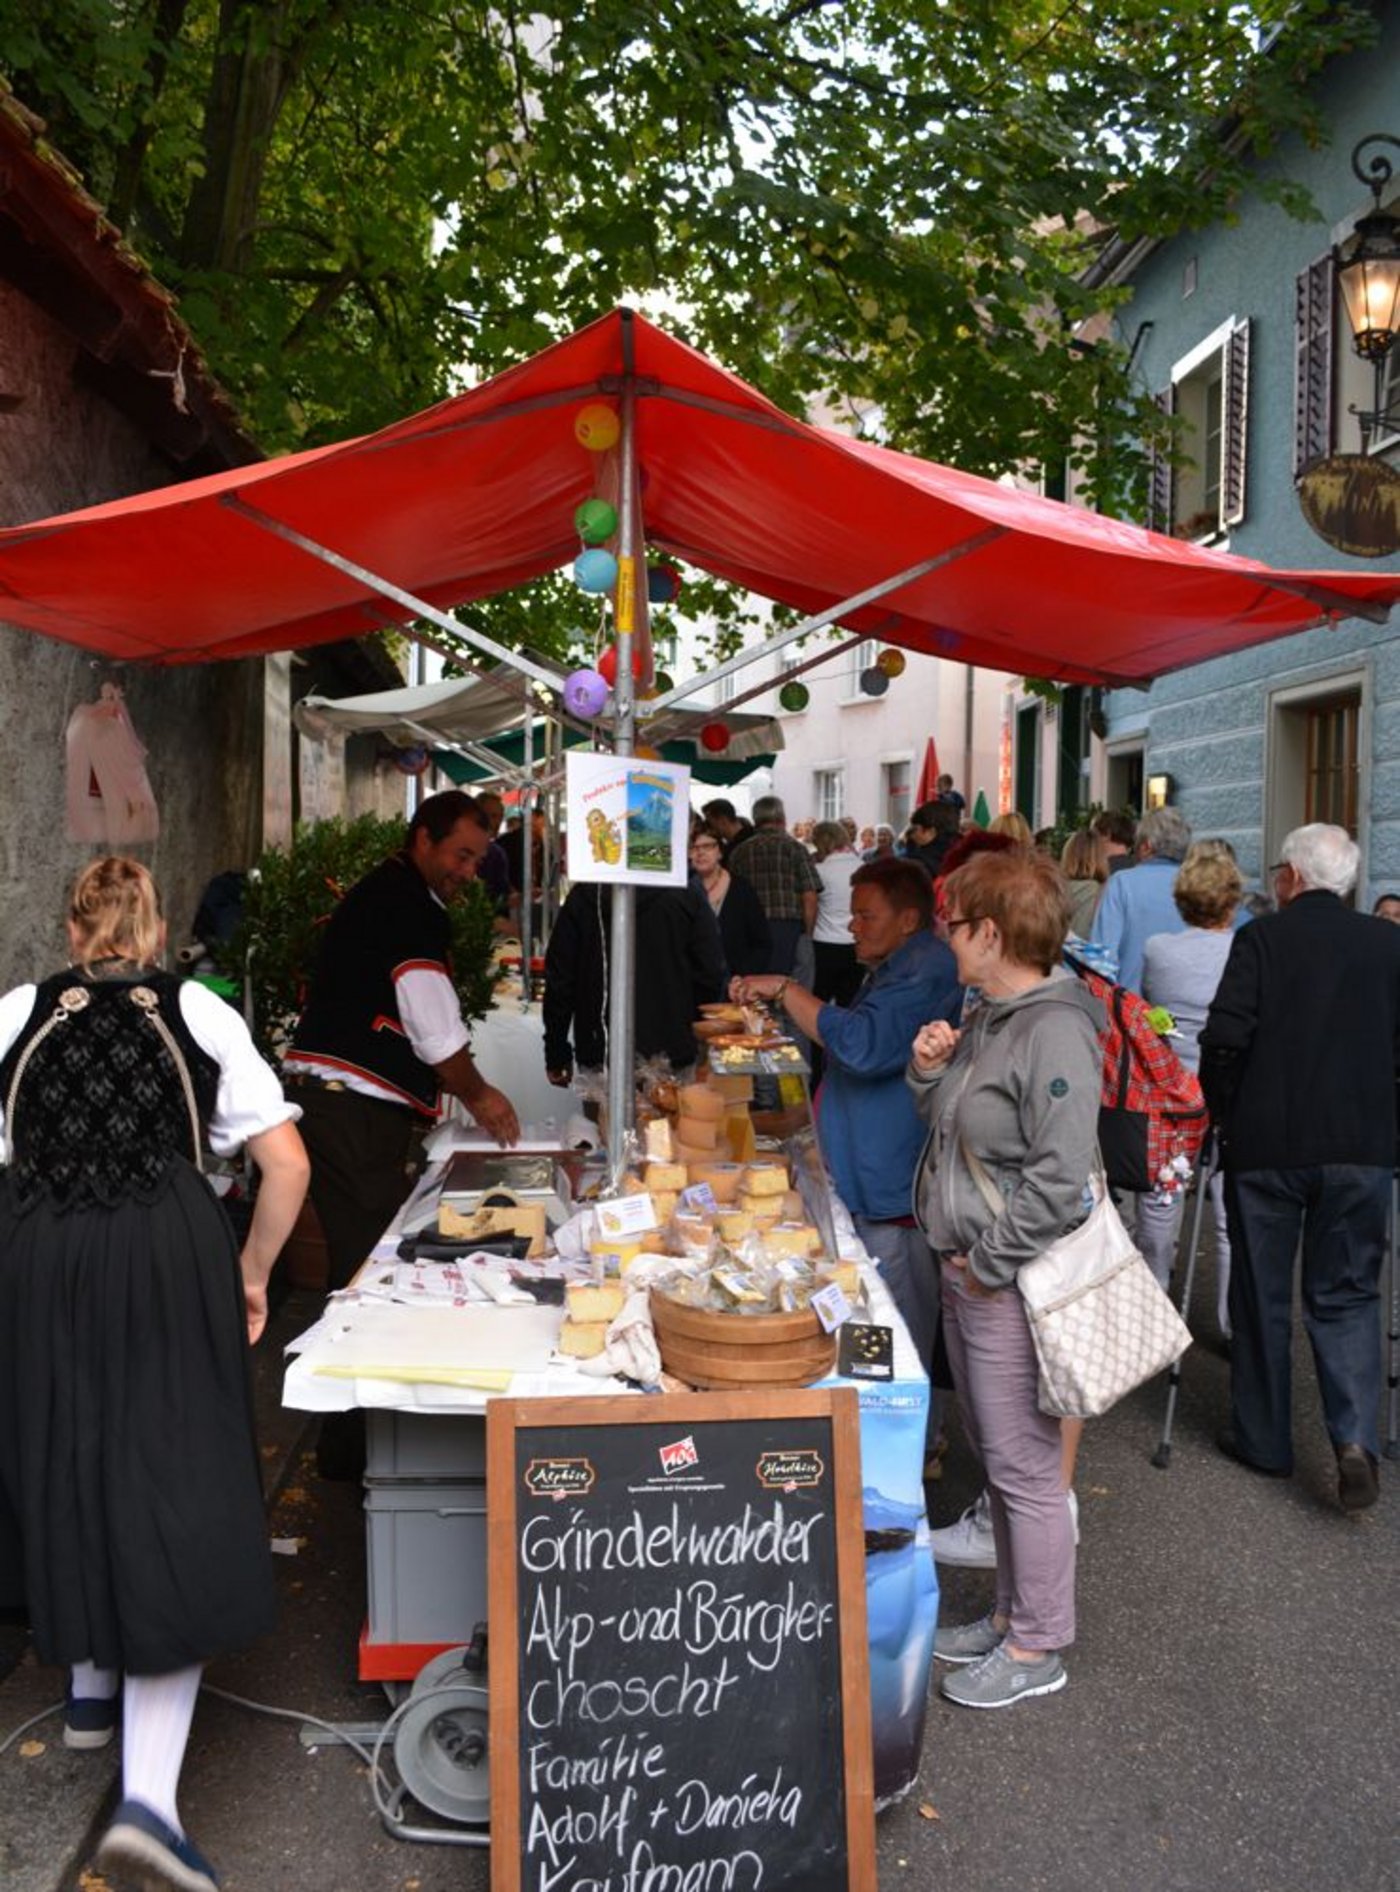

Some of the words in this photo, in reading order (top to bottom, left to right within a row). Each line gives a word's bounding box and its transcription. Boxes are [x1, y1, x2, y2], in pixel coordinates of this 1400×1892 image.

[521, 1501, 824, 1572] Grindelwalder
[529, 1732, 666, 1793] Familie
[528, 1785, 638, 1867] Adolf
[650, 1798, 668, 1829] +
[675, 1765, 803, 1835] Daniela
